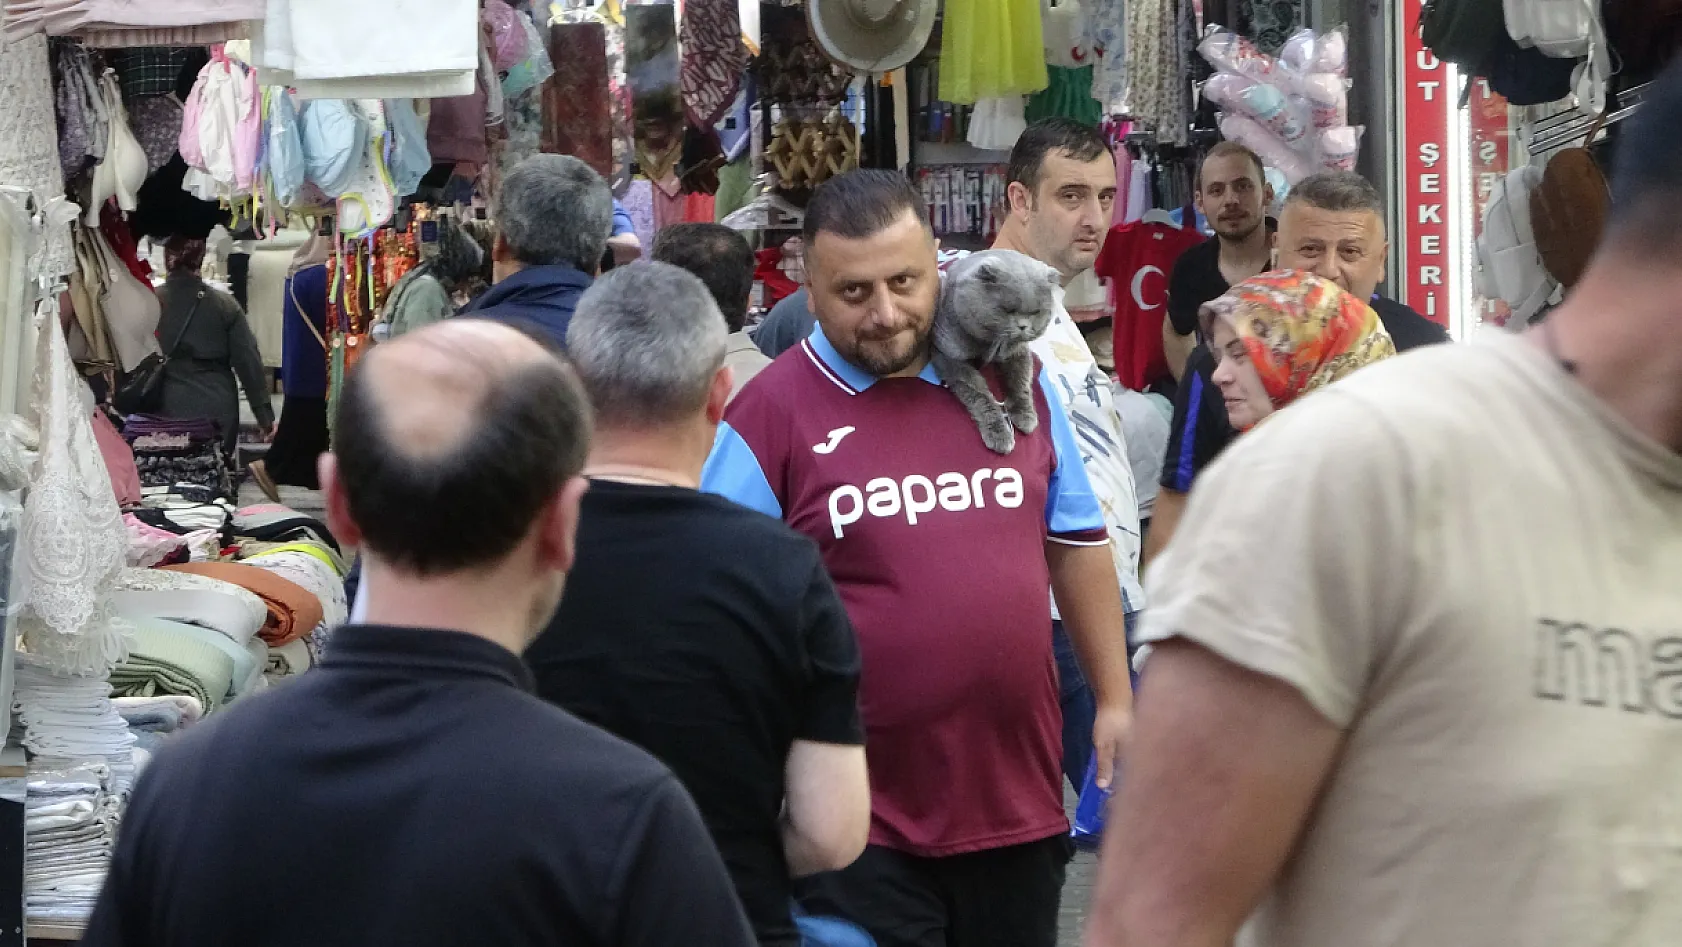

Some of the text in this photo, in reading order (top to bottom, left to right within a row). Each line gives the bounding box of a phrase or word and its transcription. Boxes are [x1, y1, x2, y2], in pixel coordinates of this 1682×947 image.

[1416, 24, 1441, 315] ÜT ŞEKERİ
[828, 467, 1024, 539] papara
